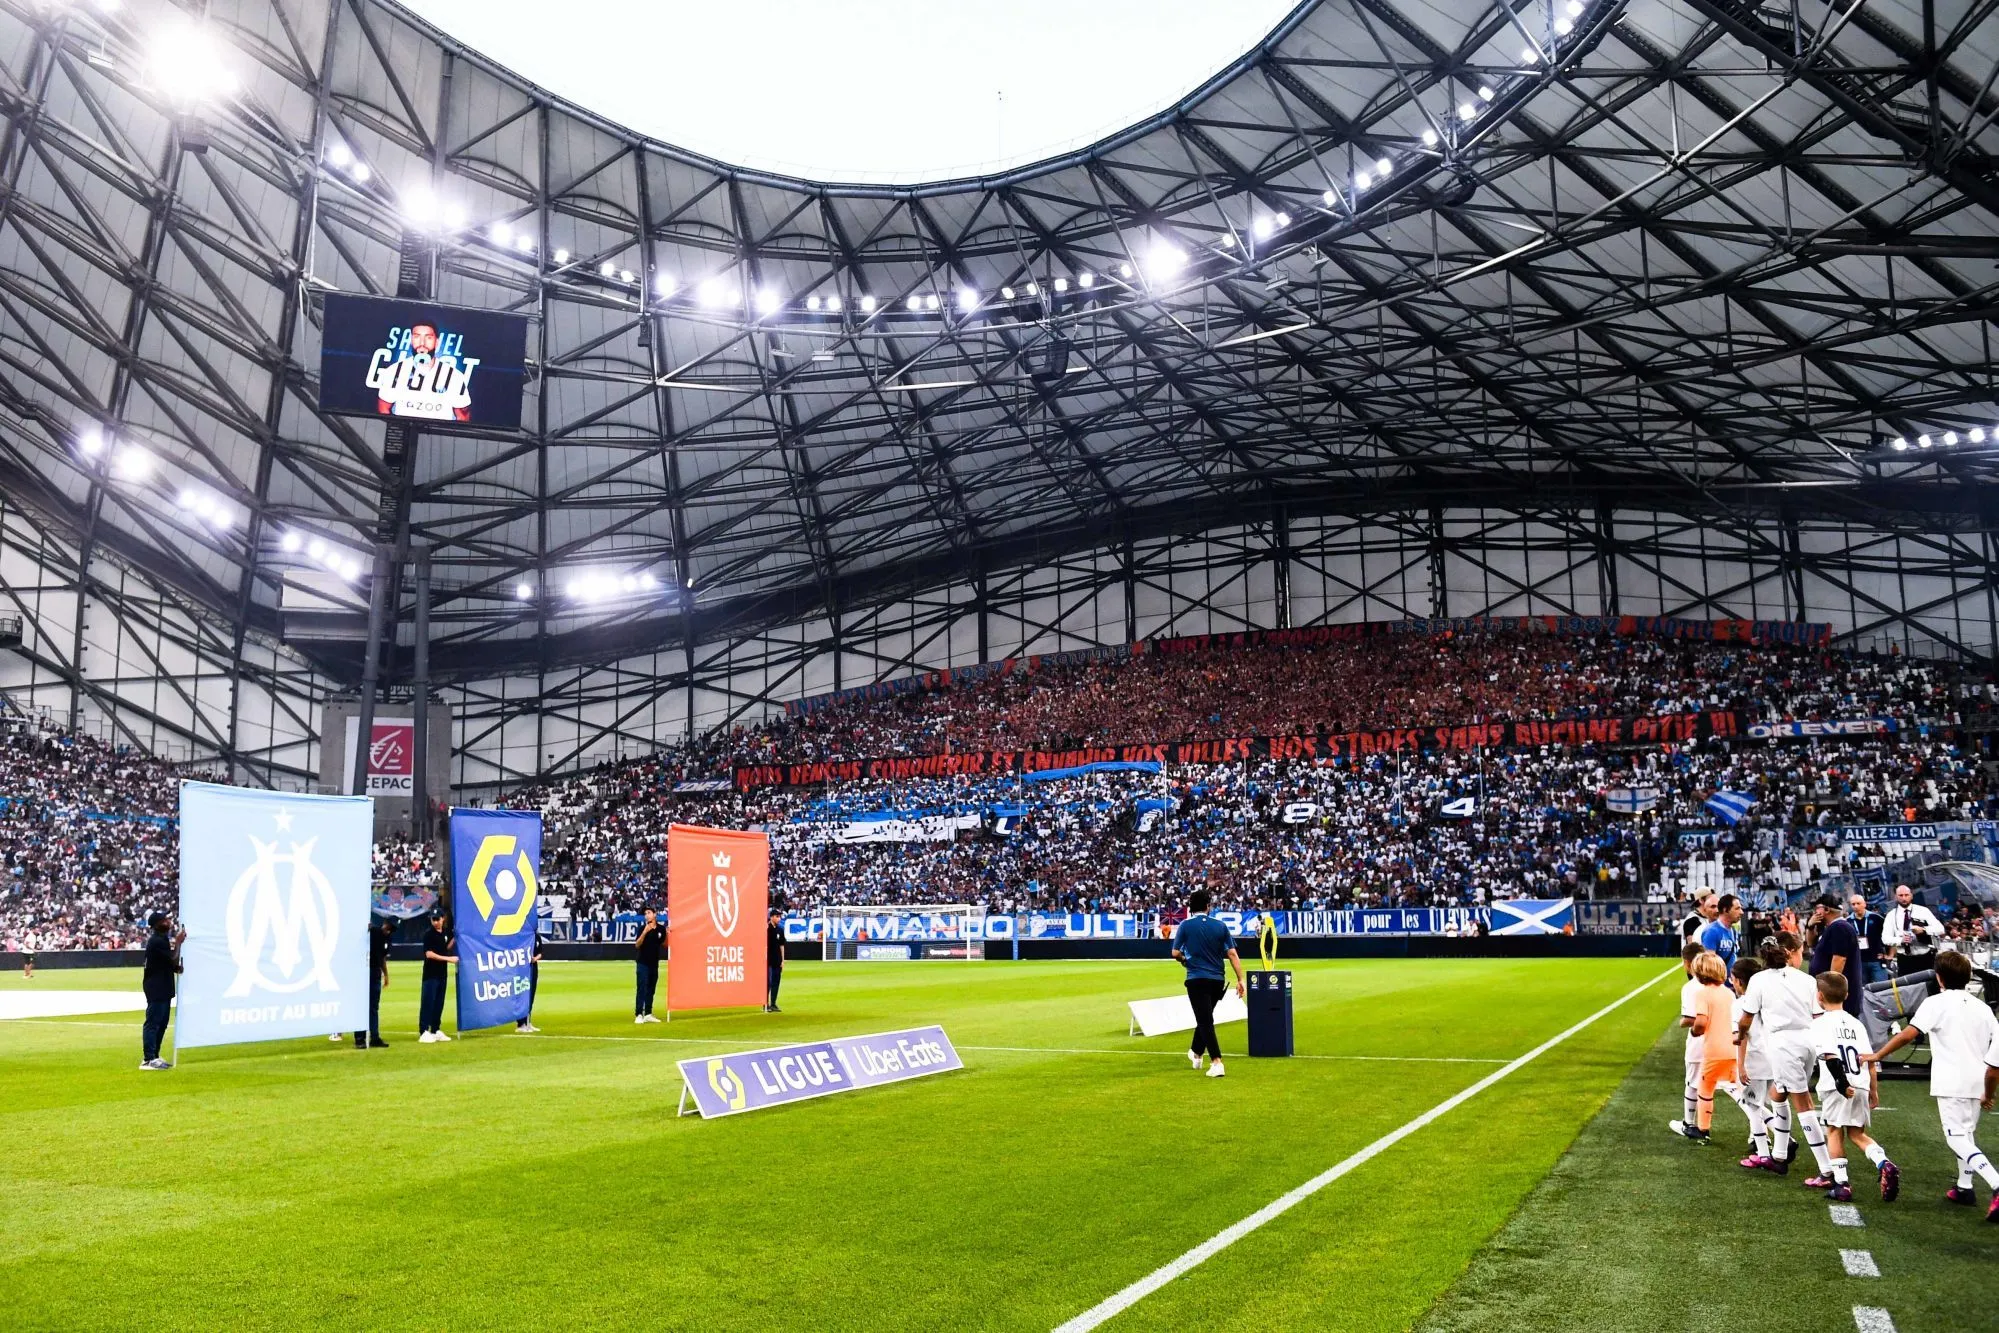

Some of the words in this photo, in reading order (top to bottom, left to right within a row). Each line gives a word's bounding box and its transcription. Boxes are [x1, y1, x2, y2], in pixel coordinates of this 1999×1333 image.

[387, 327, 464, 357] SAEL
[365, 348, 481, 396] GIGOT
[737, 766, 783, 787] NOUS
[790, 761, 862, 785] VENONS
[1123, 743, 1169, 763] VOS
[1178, 738, 1253, 764] VILLES
[1269, 736, 1318, 760] VOS
[1328, 729, 1424, 756] STADES
[1435, 725, 1504, 748] SANS
[1515, 719, 1622, 744] AUCUNE
[1283, 803, 1317, 823] 8
[1441, 797, 1476, 817] 4
[1845, 827, 1888, 840] ALLEZ
[1909, 827, 1936, 838] OM
[783, 915, 1014, 940] COMMANDO
[1287, 910, 1354, 934] LIBERTE
[1363, 912, 1392, 932] pour
[1402, 910, 1420, 929] les
[476, 949, 526, 972] LIGUE
[707, 946, 744, 963] STADE
[707, 965, 744, 983] REIMS
[474, 980, 512, 1002] Uber
[220, 1006, 280, 1025] DROIT
[282, 1004, 306, 1021] AU
[310, 1001, 341, 1018] BUT
[751, 1051, 842, 1096] LIGUE
[835, 1048, 856, 1081] 1
[853, 1045, 905, 1078] Uber
[896, 1038, 947, 1068] Eats
[1837, 1044, 1861, 1076] 10
